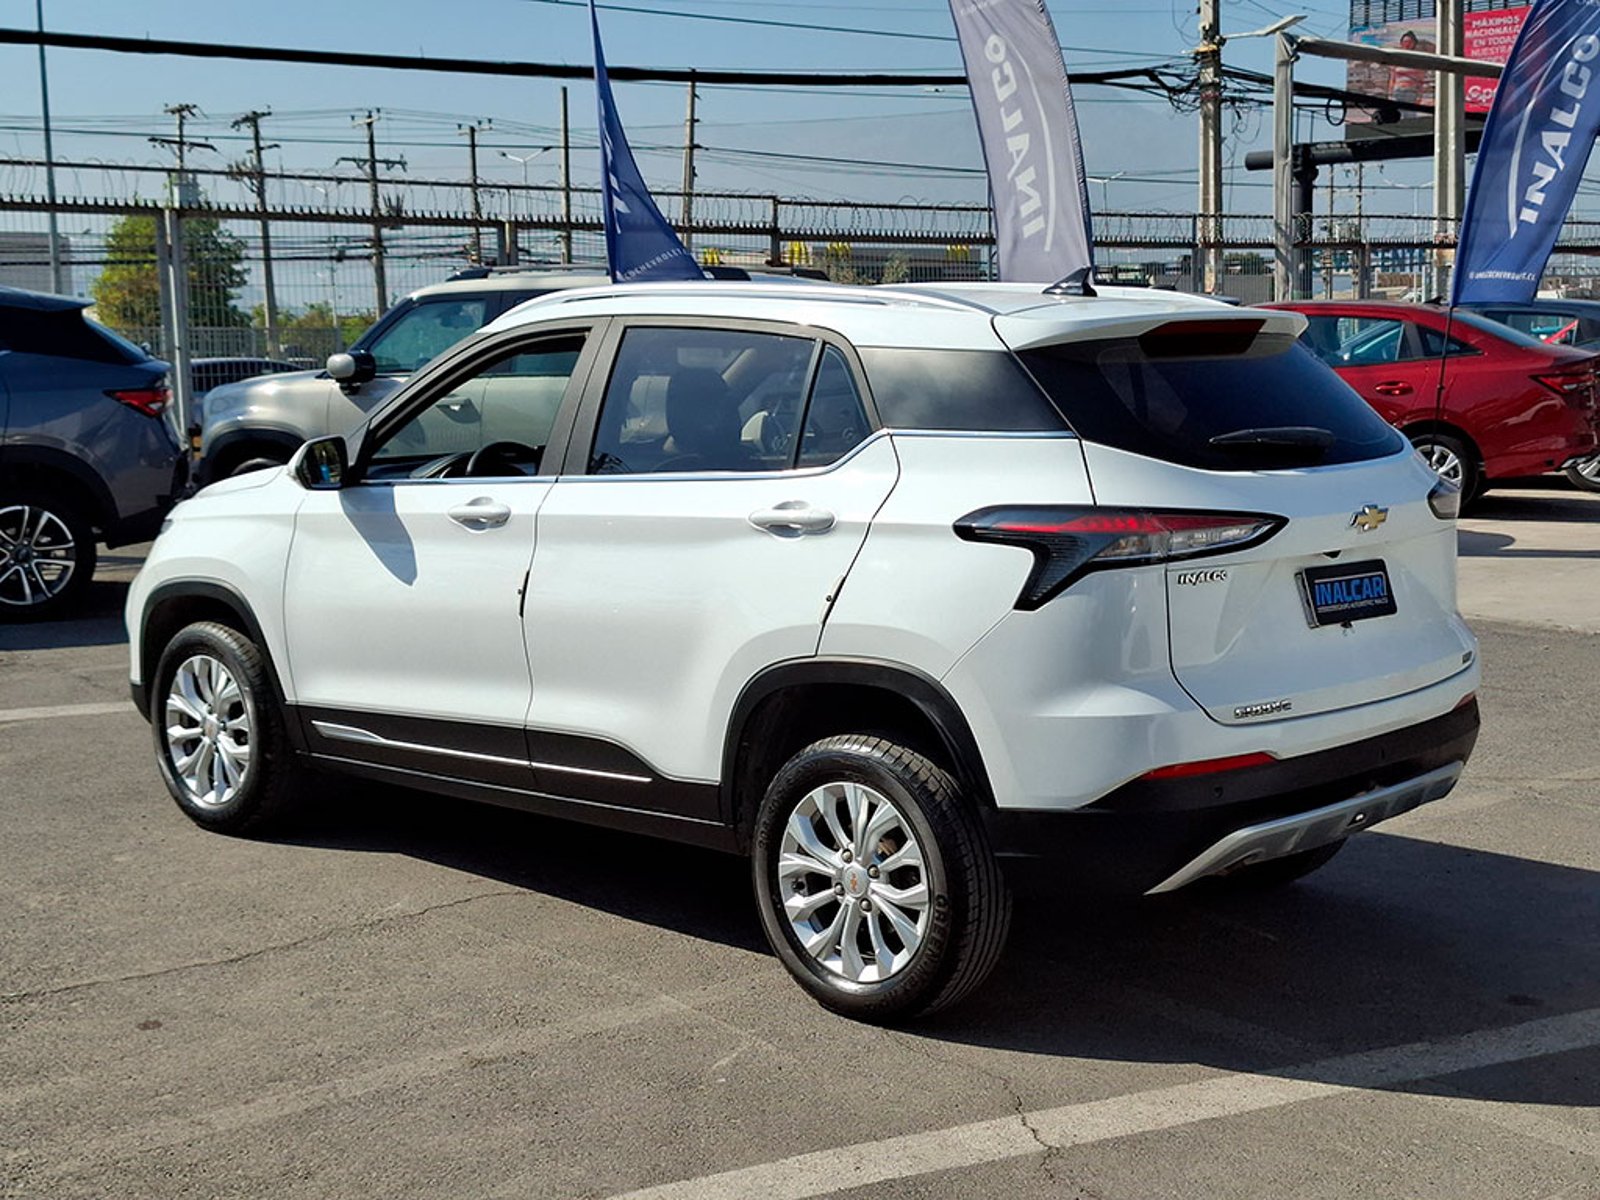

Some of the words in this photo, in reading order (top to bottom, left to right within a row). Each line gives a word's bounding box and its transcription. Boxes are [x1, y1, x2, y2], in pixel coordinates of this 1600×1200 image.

[1465, 25, 1520, 39] NACIONALE
[1471, 45, 1513, 57] NUESTRA
[1519, 34, 1599, 225] INALCO
[1314, 576, 1385, 606] INALCAR
